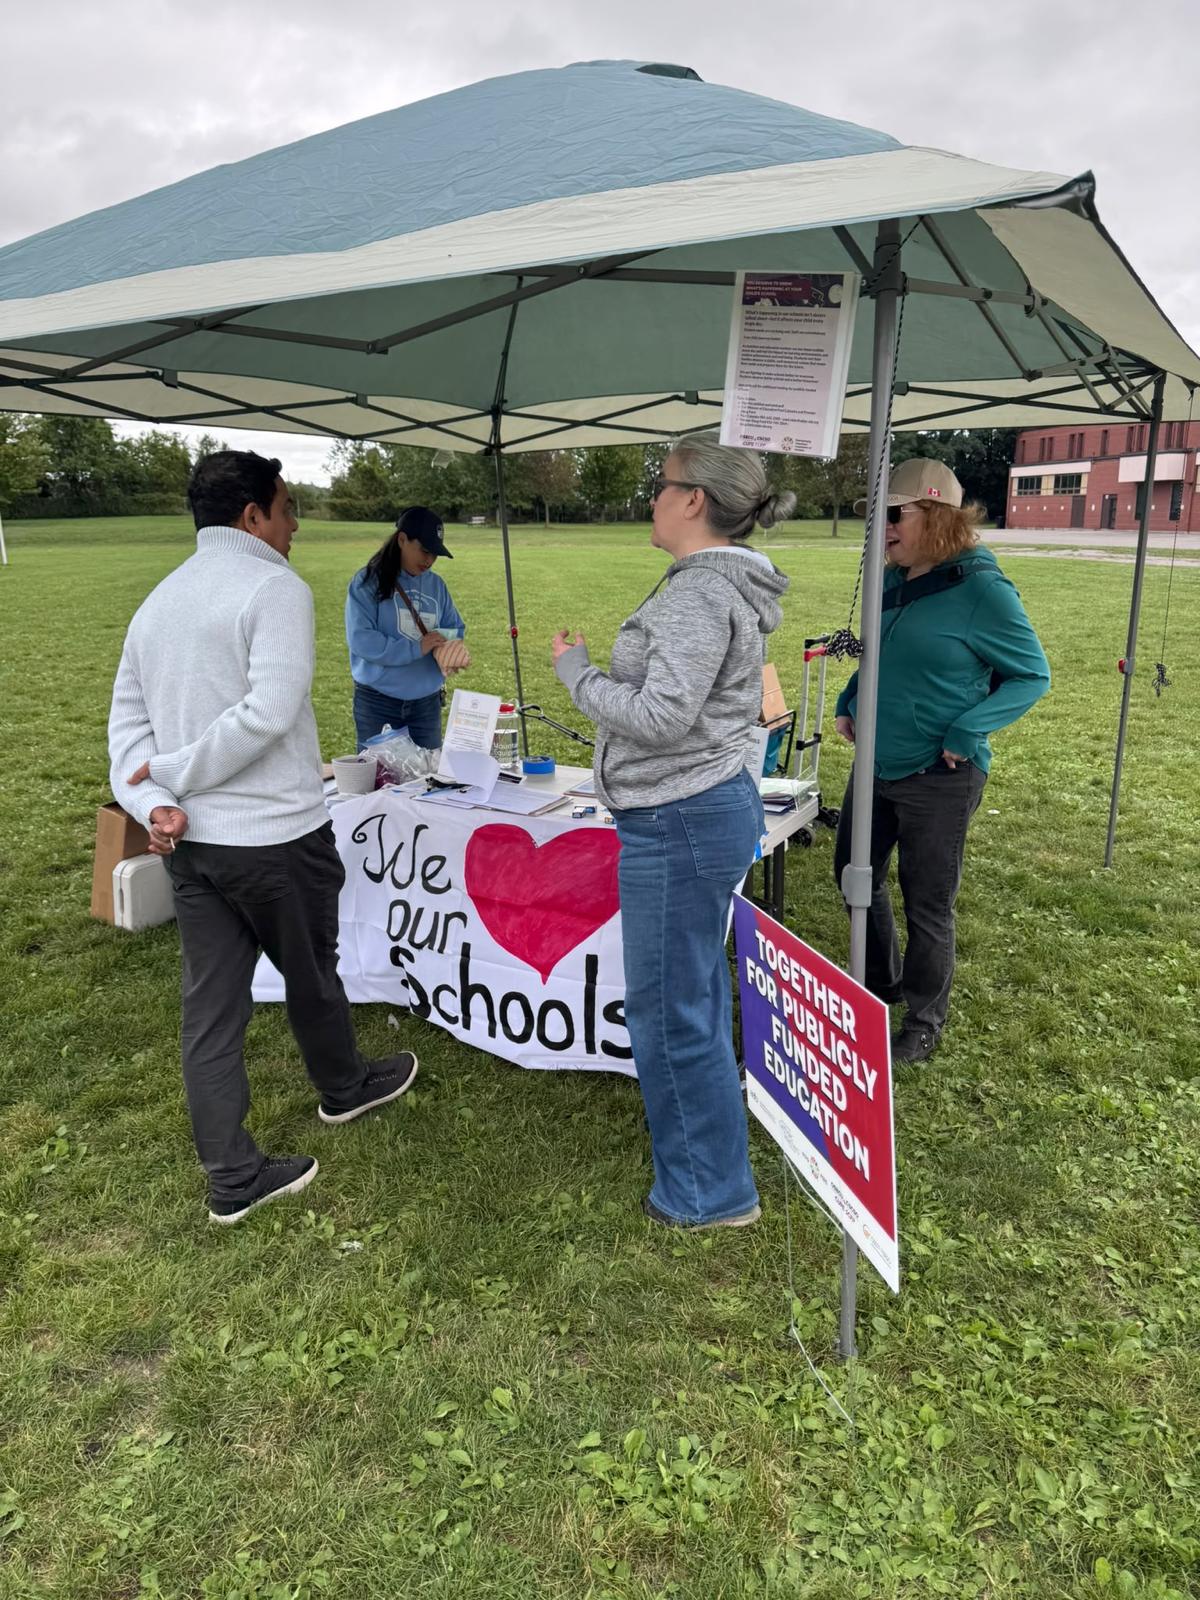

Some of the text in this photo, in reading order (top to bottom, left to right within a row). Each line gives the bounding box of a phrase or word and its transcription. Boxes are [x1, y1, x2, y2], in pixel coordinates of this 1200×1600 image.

[351, 813, 451, 894] We
[386, 899, 468, 954] our
[389, 942, 633, 1060] Schools
[746, 956, 878, 1101] FOR PUBLICLY
[755, 929, 857, 1042] TOGETHER
[763, 1040, 870, 1182] EDUCATION
[771, 1013, 848, 1112] FUNDED
